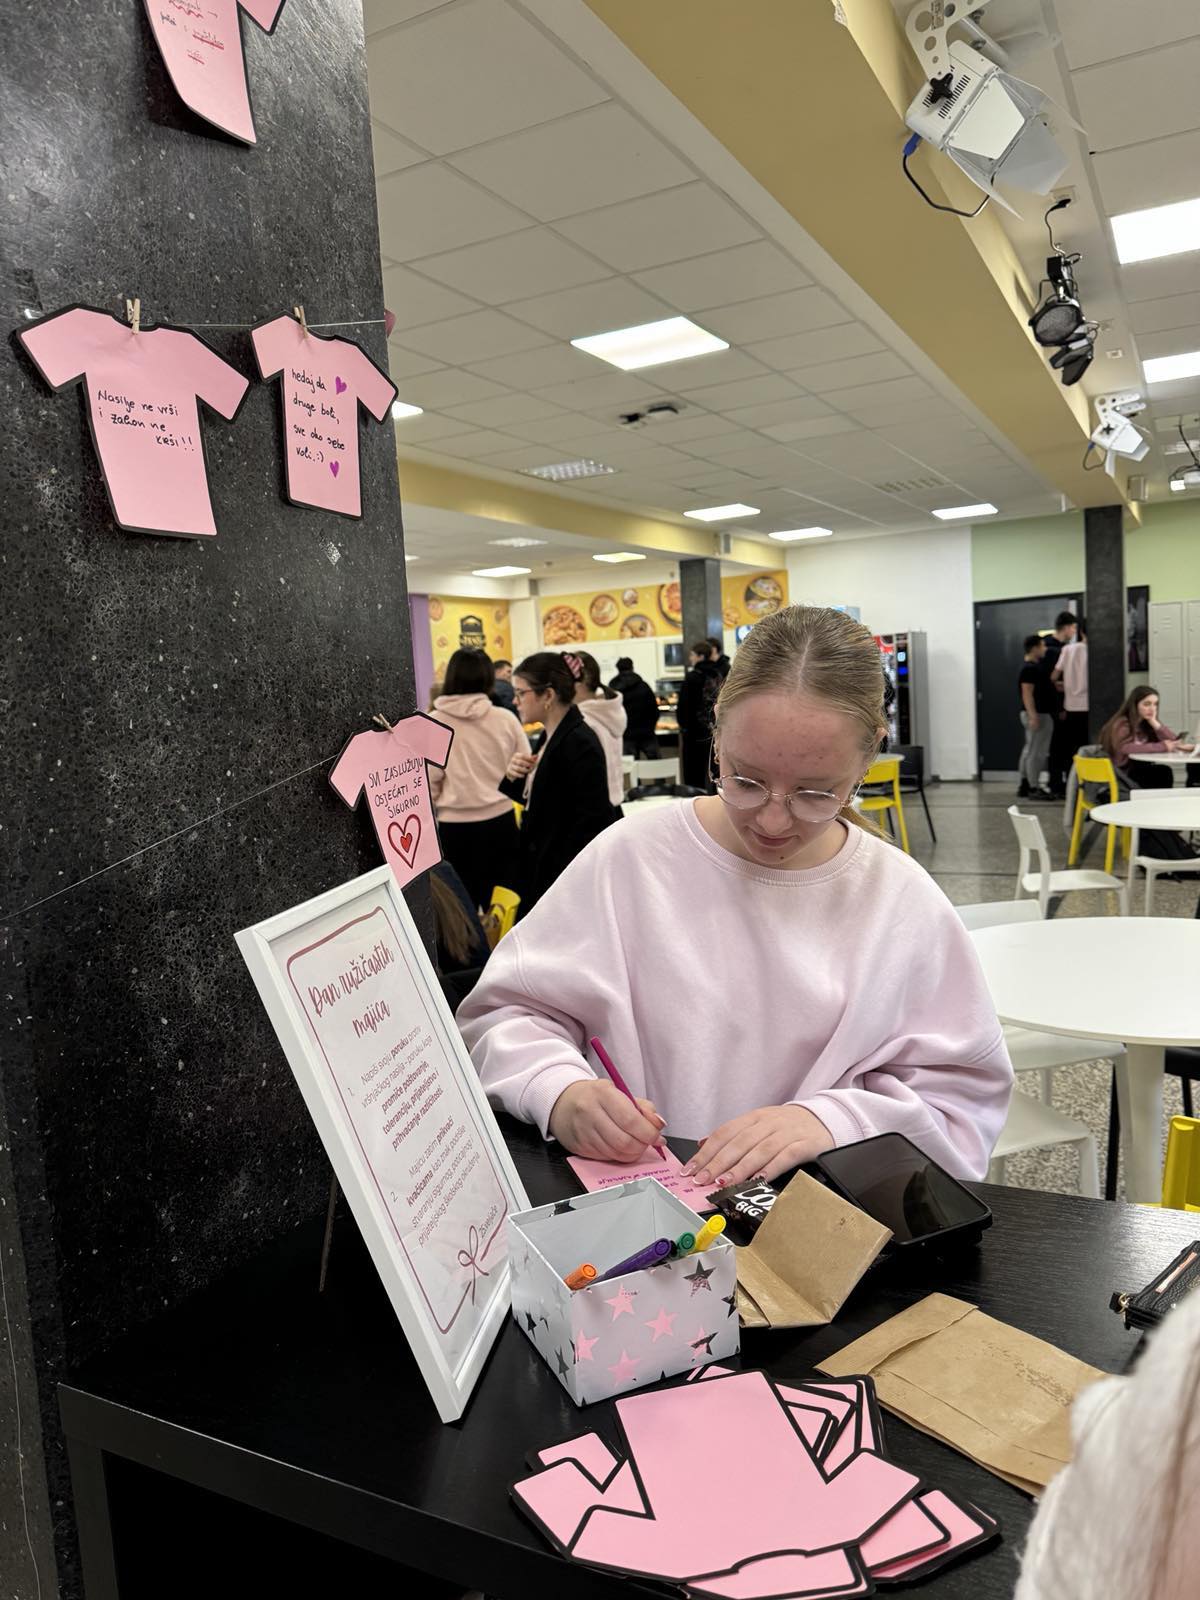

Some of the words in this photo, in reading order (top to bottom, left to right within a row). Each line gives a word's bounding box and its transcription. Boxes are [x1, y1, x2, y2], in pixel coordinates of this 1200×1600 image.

[316, 376, 327, 391] da
[98, 390, 135, 413] Nasilje
[141, 403, 154, 412] ne
[157, 404, 179, 416] vrši
[98, 407, 103, 417] i
[150, 422, 166, 431] ne
[293, 392, 316, 417] druge
[293, 424, 306, 437] sve
[327, 437, 345, 450] sebe
[369, 771, 381, 788] SVI
[384, 756, 423, 782] ZASLUŽUJU
[375, 784, 409, 807] OSJEĆATI
[413, 776, 422, 788] SE
[387, 794, 420, 819] SIGURNO
[307, 983, 341, 1018] Dan
[338, 939, 394, 995] ružičastih
[352, 1000, 390, 1038] majica
[361, 1066, 379, 1084] Napiši
[378, 1054, 392, 1070] svoju
[391, 1037, 408, 1056] poruku
[361, 1079, 390, 1108] vršnjačkog
[388, 1064, 405, 1081] nasilja
[407, 1044, 423, 1062] poruku
[381, 1087, 403, 1113] promiče
[383, 1101, 411, 1134] toleranciju,
[410, 1073, 436, 1103] prijateljstvo
[392, 1114, 420, 1151] prihvaćanje
[409, 1155, 425, 1178] Majicu
[424, 1139, 437, 1157] zatim
[436, 1116, 453, 1141] prikvači
[407, 1170, 432, 1206] kvačicama
[431, 1156, 440, 1171] kao
[439, 1144, 450, 1162] znak
[411, 1195, 433, 1227] stvaranju
[418, 1202, 445, 1247] prijateljskog
[443, 1176, 462, 1207] školskog
[734, 1185, 777, 1211] CO
[735, 1201, 763, 1216] BIG
